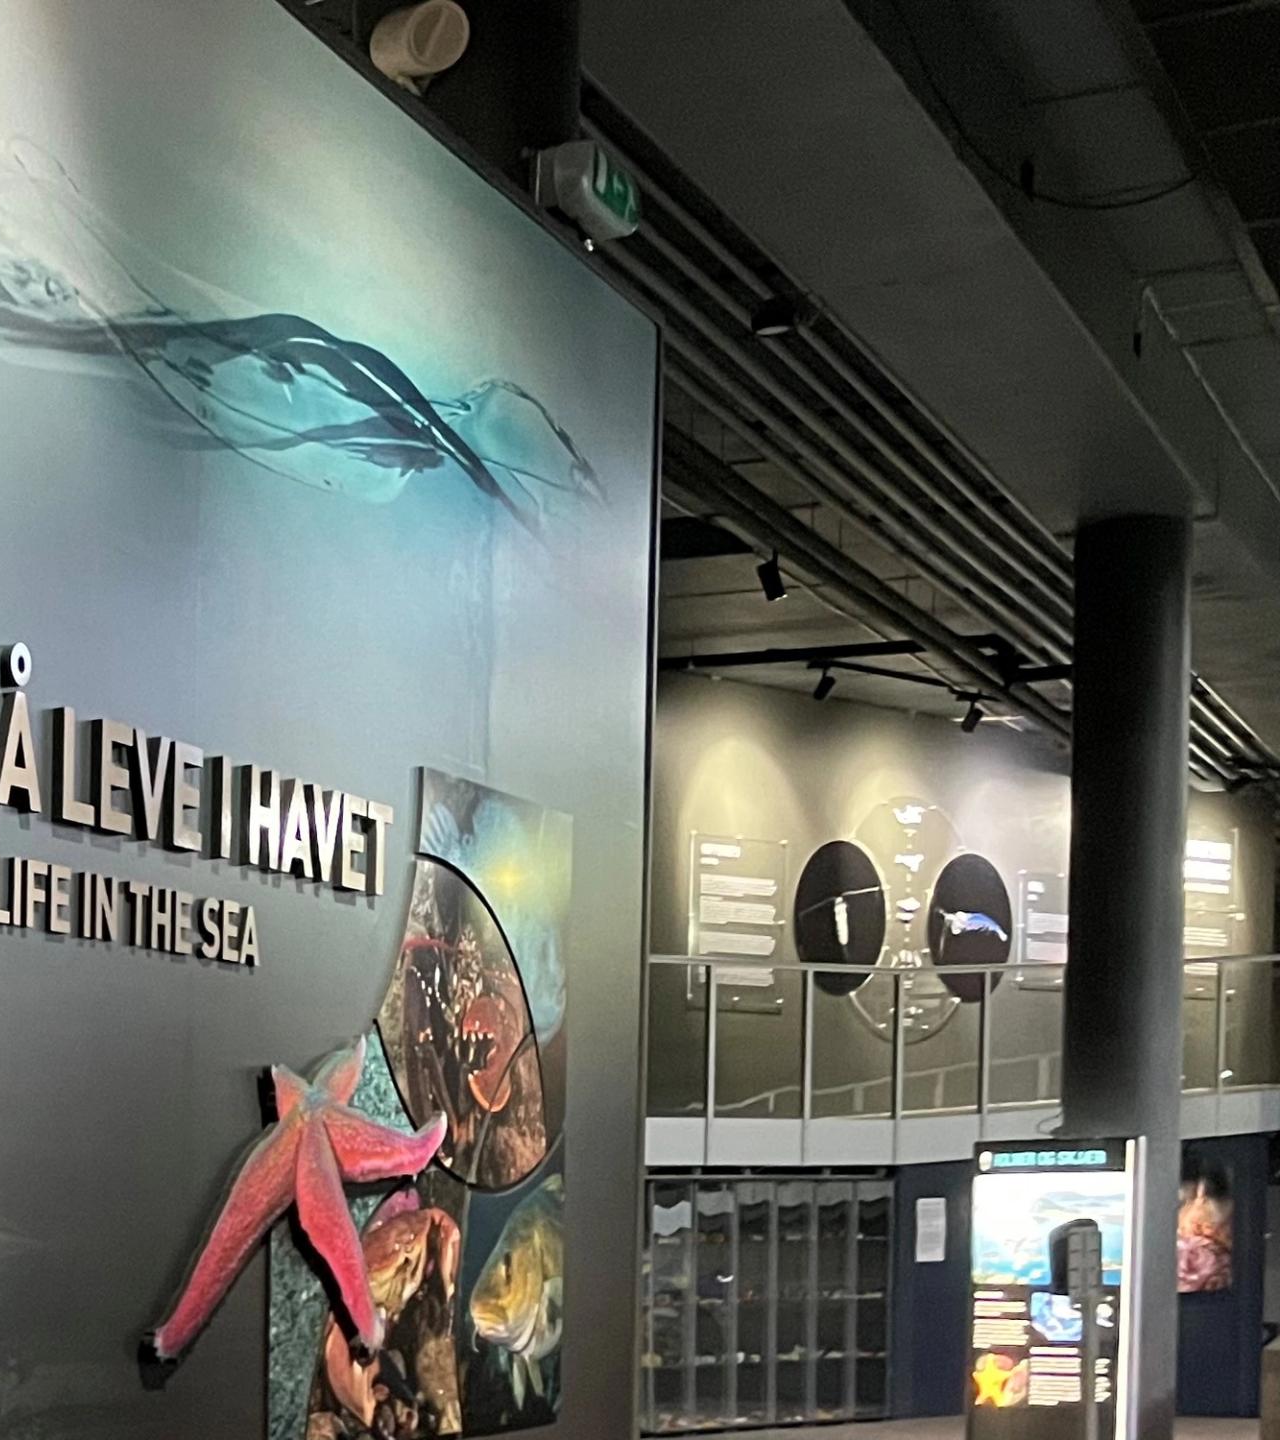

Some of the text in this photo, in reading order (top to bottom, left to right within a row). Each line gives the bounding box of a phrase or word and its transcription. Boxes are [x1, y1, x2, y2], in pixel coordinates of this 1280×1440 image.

[53, 705, 205, 853] LEVE
[211, 755, 233, 859] I
[242, 763, 395, 896] HAVET
[78, 871, 119, 941] IN
[126, 880, 194, 955] THE
[199, 896, 261, 967] SEA
